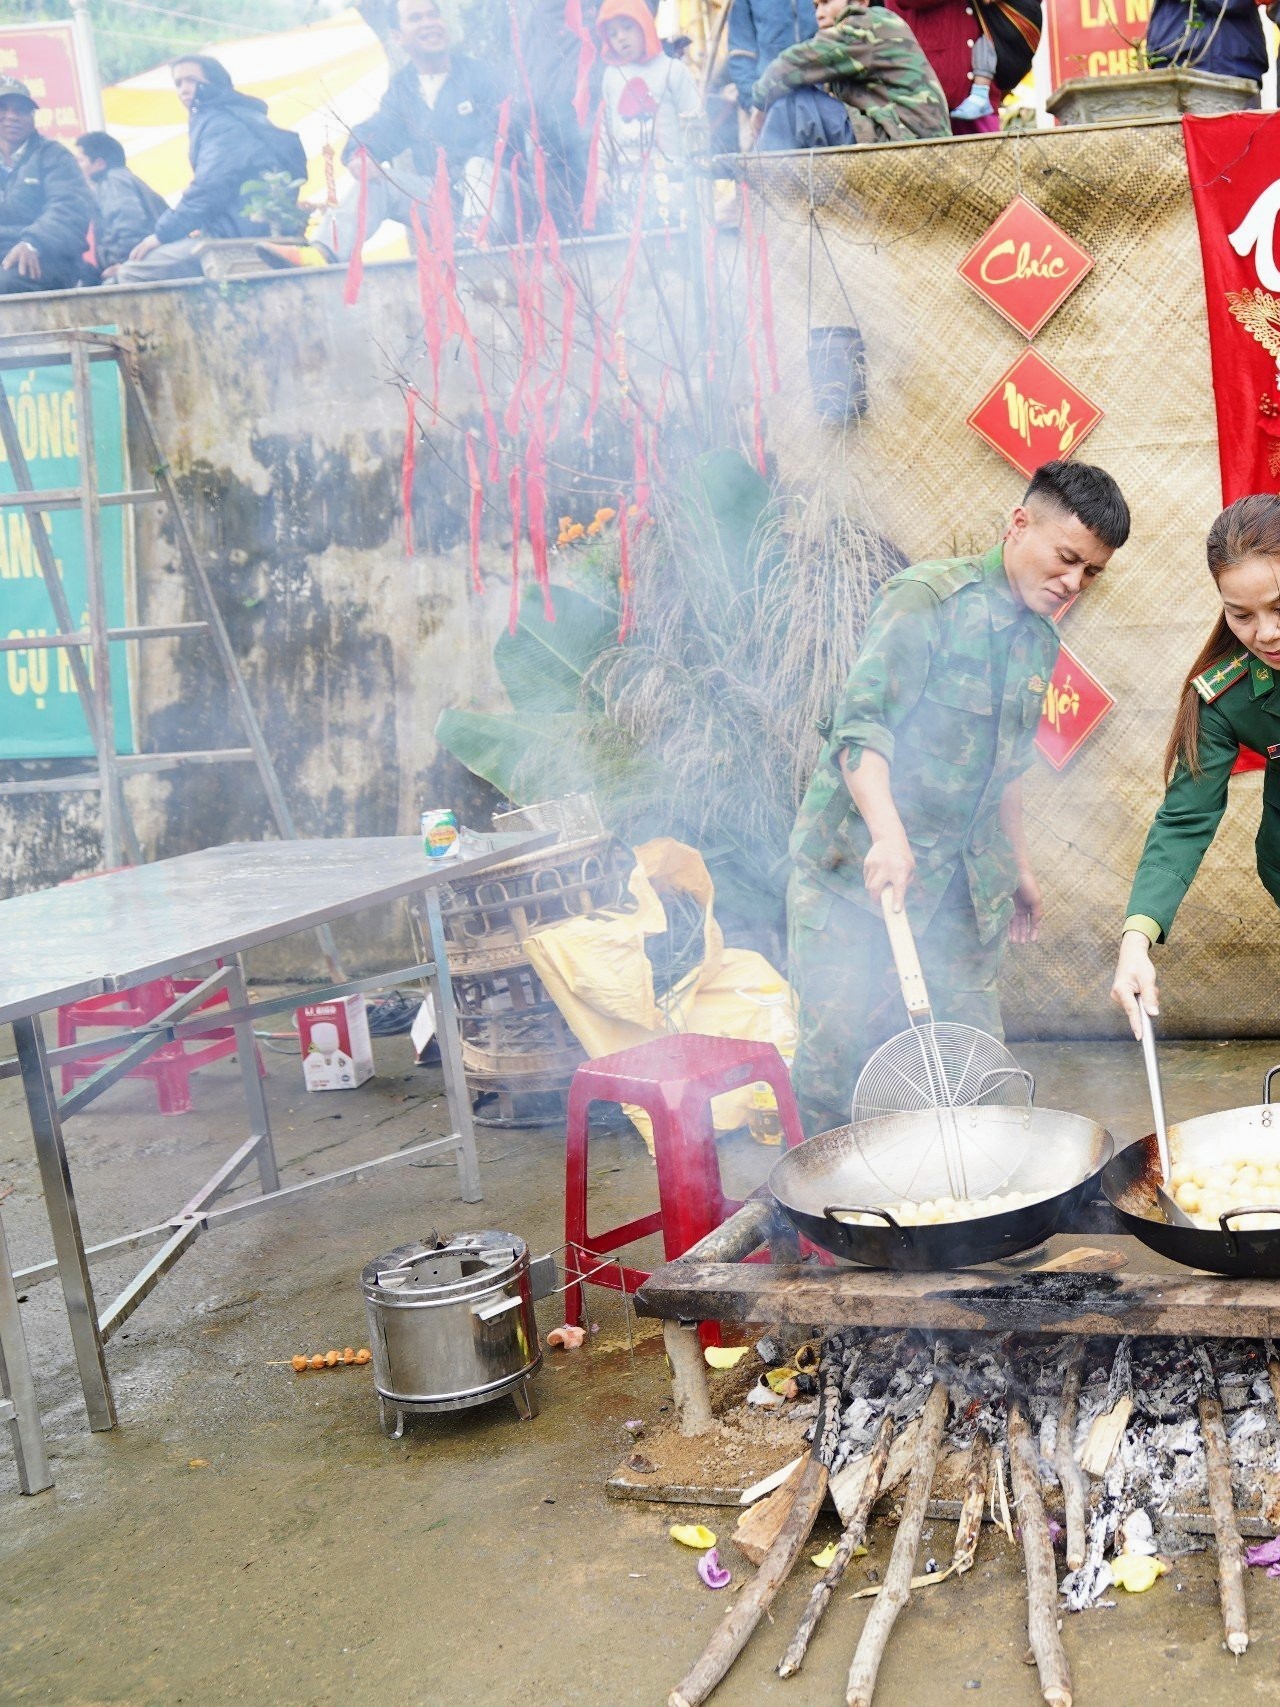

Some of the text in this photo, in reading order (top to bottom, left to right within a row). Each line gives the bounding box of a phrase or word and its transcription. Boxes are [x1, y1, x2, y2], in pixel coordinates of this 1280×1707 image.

[1125, 0, 1154, 24] N
[980, 239, 1069, 284] Chúc
[1003, 381, 1083, 451] Mừng
[1042, 674, 1080, 733] Mới
